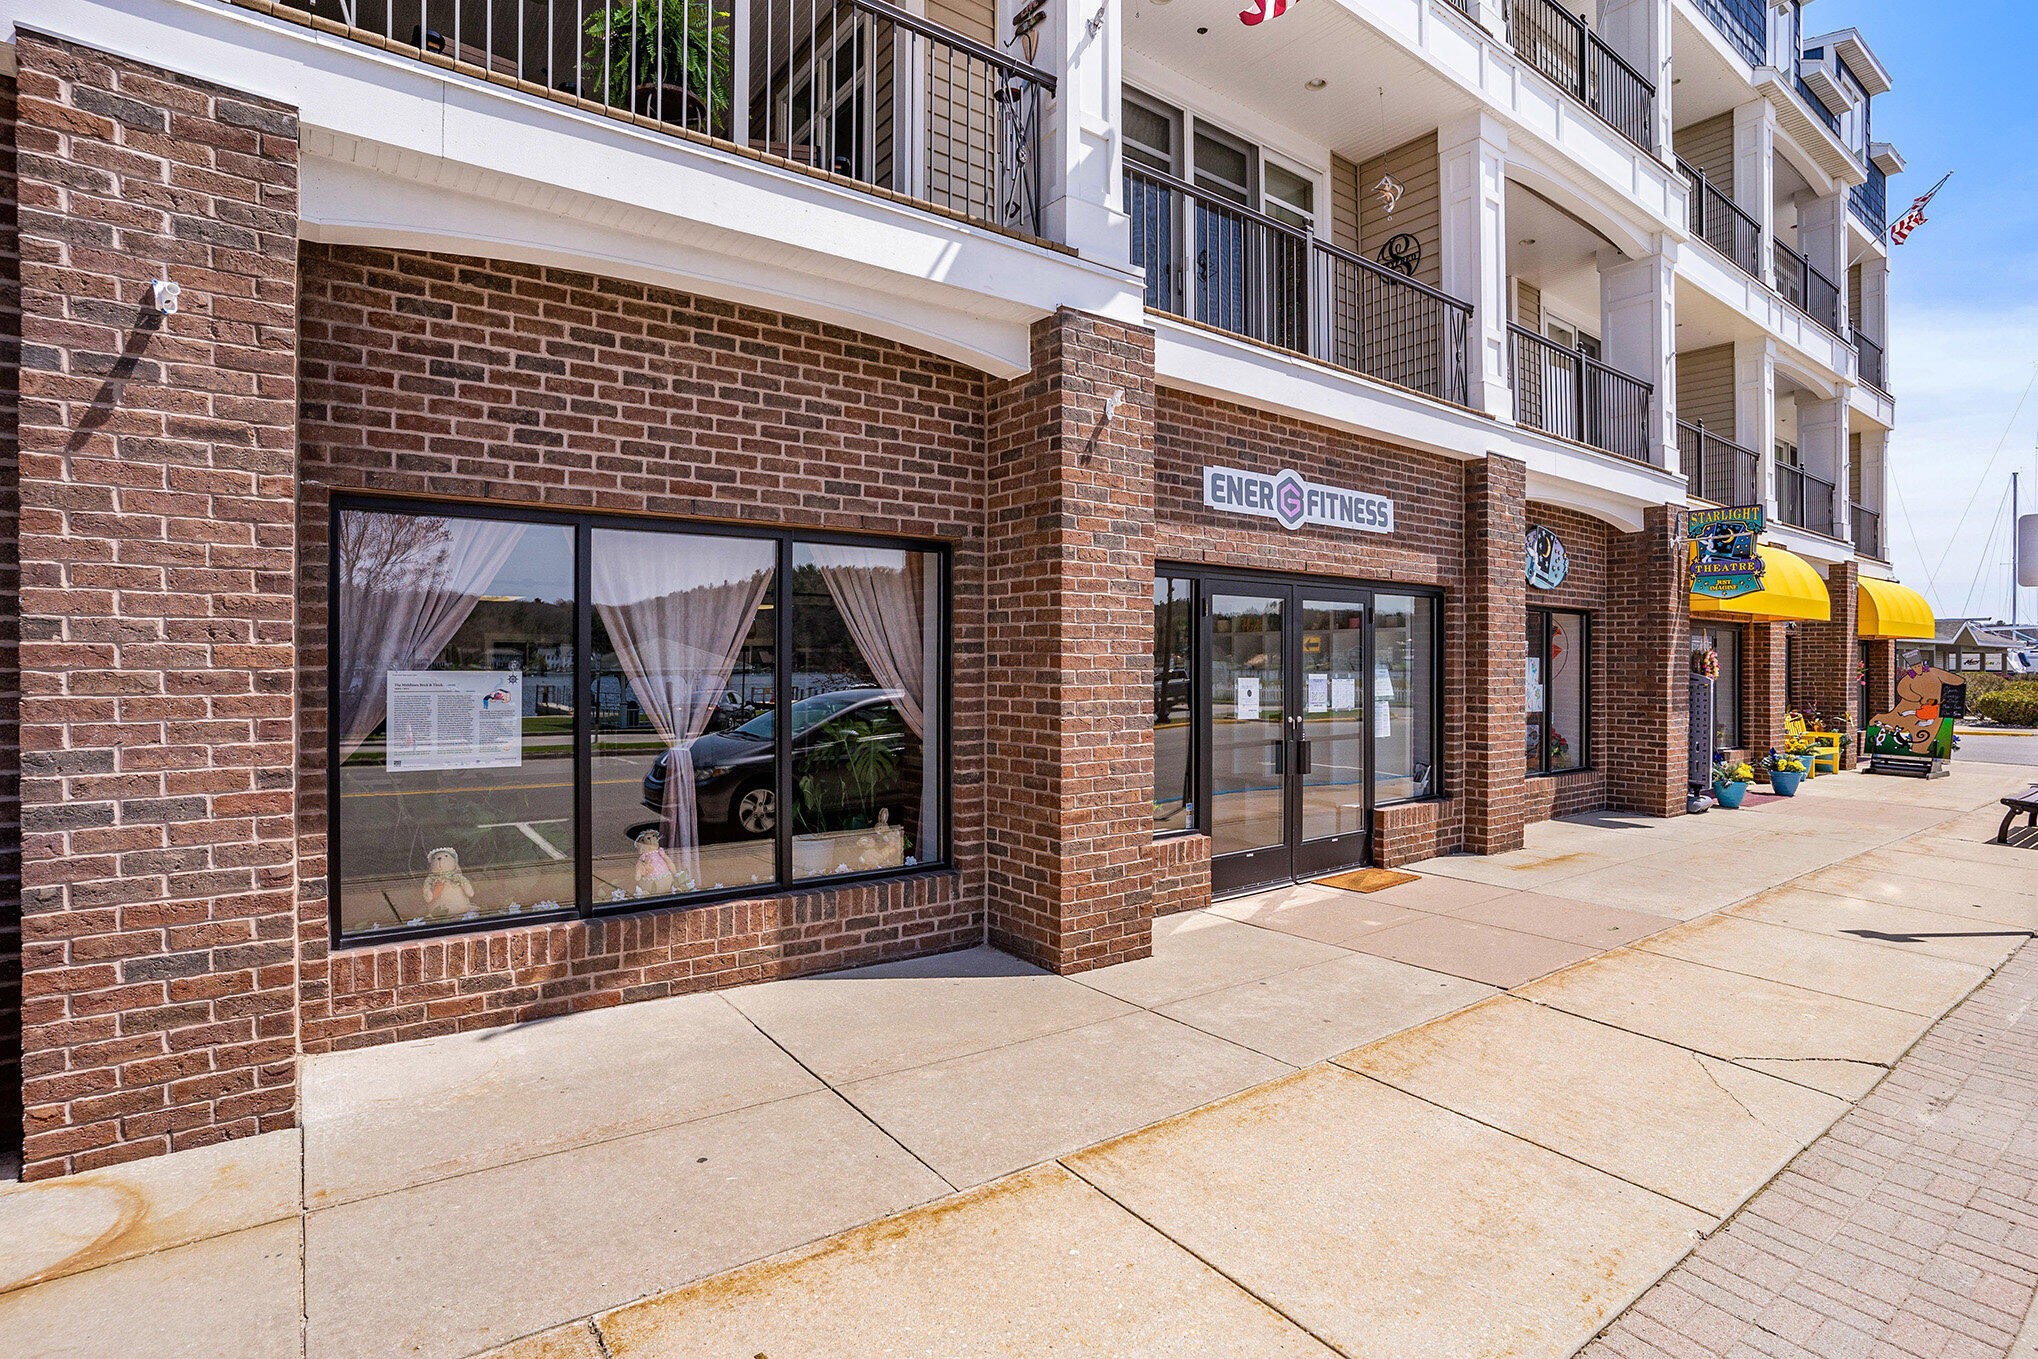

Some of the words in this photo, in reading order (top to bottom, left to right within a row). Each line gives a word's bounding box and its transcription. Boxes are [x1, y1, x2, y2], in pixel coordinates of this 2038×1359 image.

[1307, 489, 1388, 528] FITNESS
[1691, 507, 1760, 527] STARLIGHT
[1695, 562, 1755, 573] THEATRE
